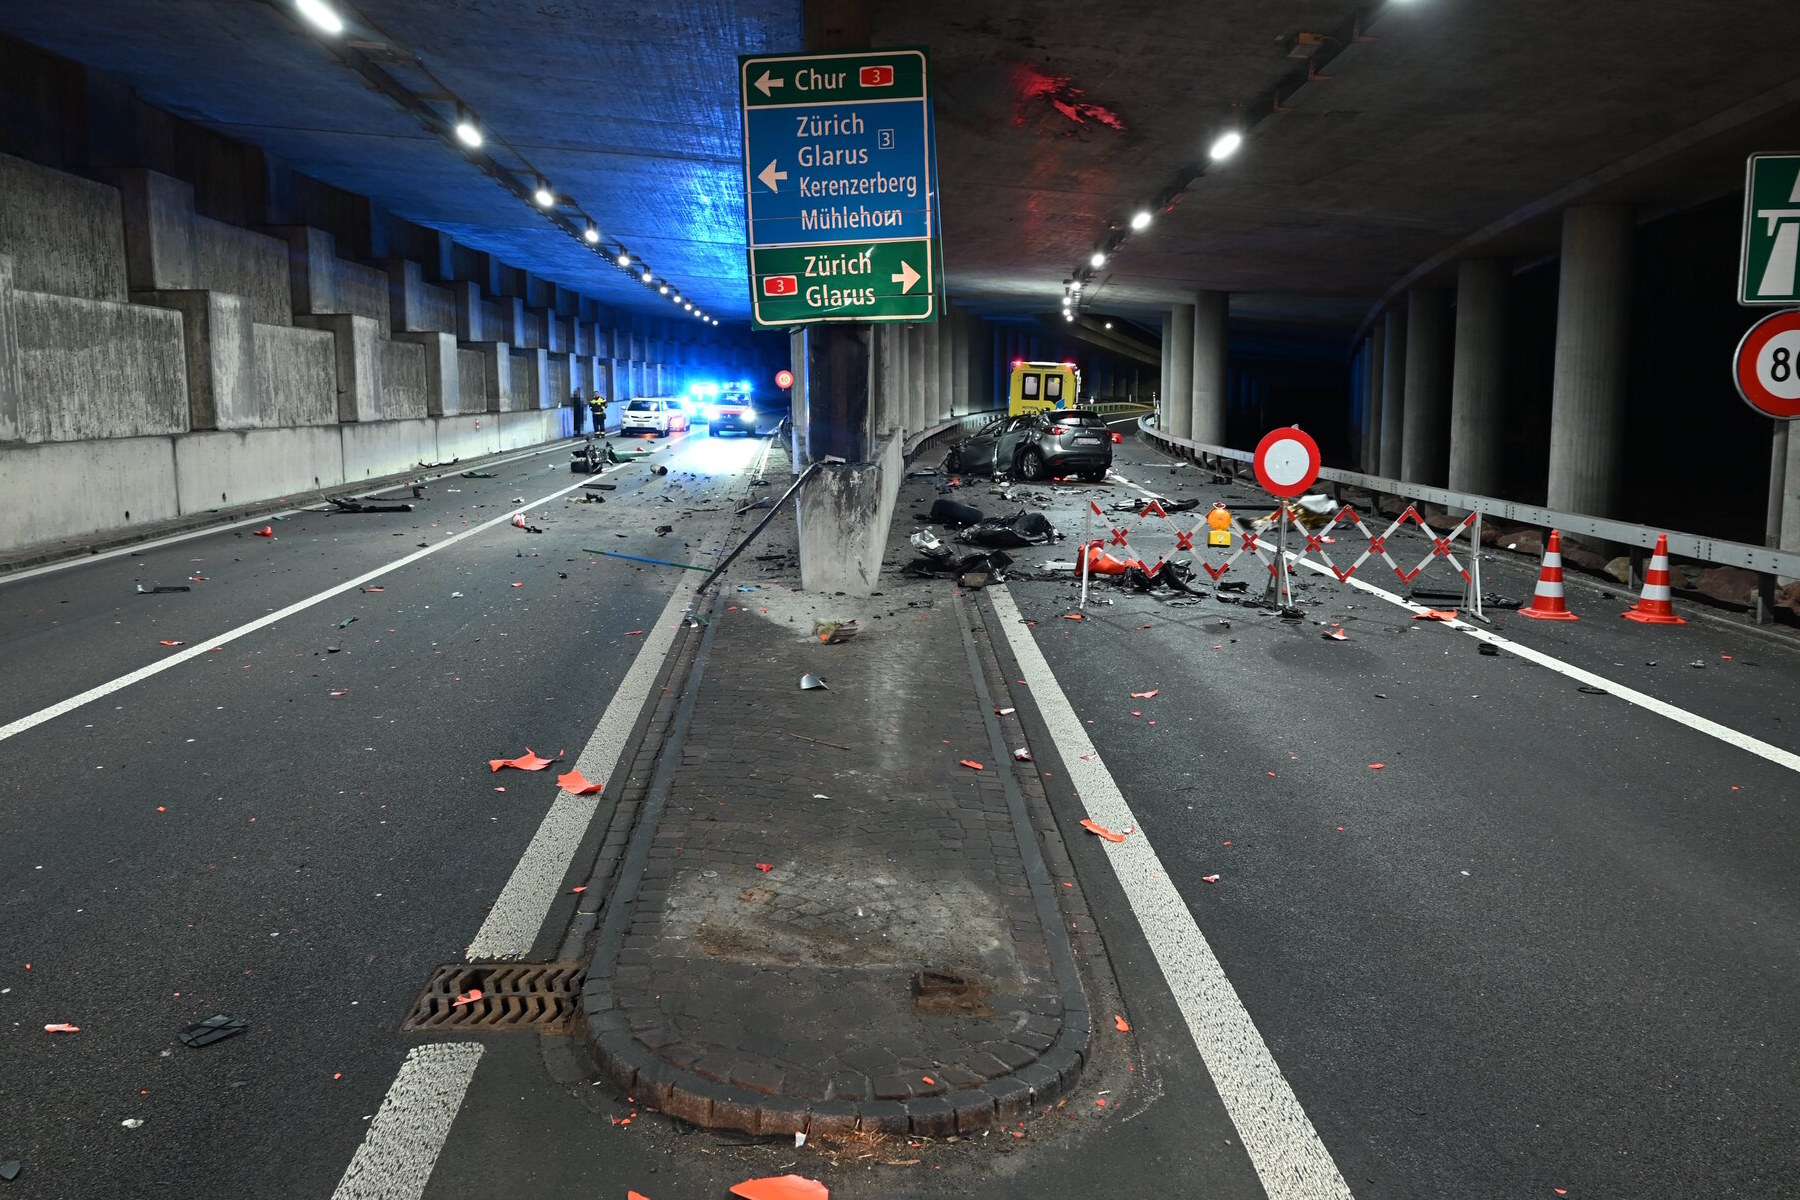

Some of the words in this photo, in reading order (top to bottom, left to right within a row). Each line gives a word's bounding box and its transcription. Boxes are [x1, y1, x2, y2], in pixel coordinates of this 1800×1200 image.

[795, 67, 847, 91] Chur
[872, 69, 881, 83] 3
[796, 112, 865, 138] Zürich
[882, 132, 891, 147] 3
[797, 144, 869, 168] Glarus
[799, 171, 917, 198] Kerenzerberg
[800, 205, 904, 231] Mühlehorn
[803, 251, 873, 278] Zürich
[776, 279, 785, 293] 3
[805, 284, 877, 308] Glarus
[1771, 347, 1800, 383] 8
